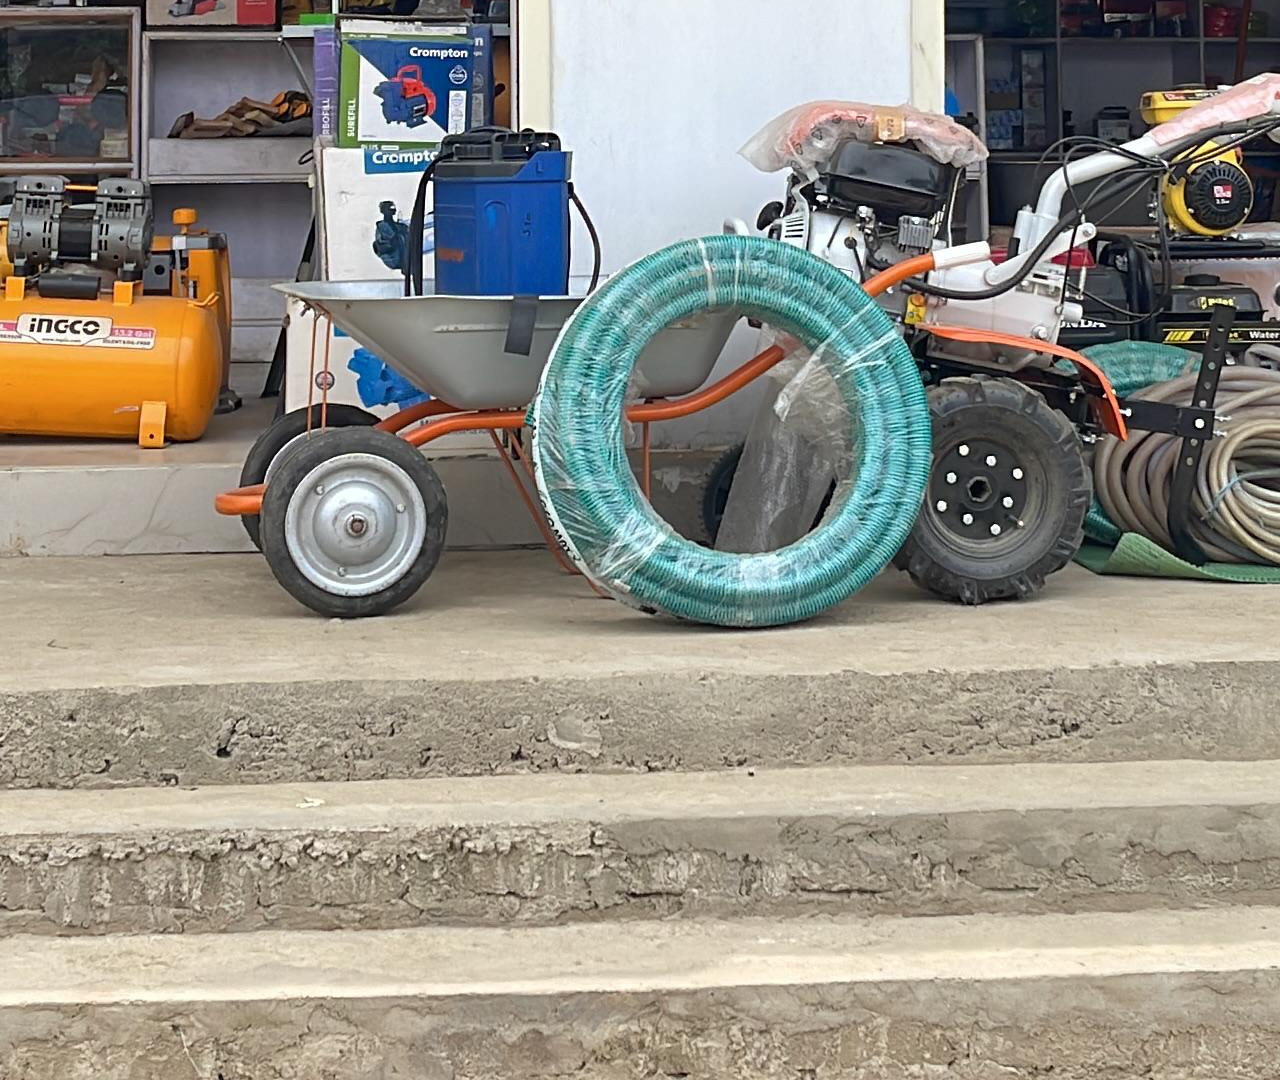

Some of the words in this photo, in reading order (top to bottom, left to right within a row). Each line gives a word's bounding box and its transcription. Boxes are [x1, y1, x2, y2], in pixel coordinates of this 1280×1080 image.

[409, 46, 469, 60] Crompton
[322, 97, 330, 135] RBOFILL
[347, 98, 356, 137] SUREFILL
[372, 149, 439, 166] Crompto
[29, 317, 100, 336] INGCO
[1249, 331, 1280, 340] Water
